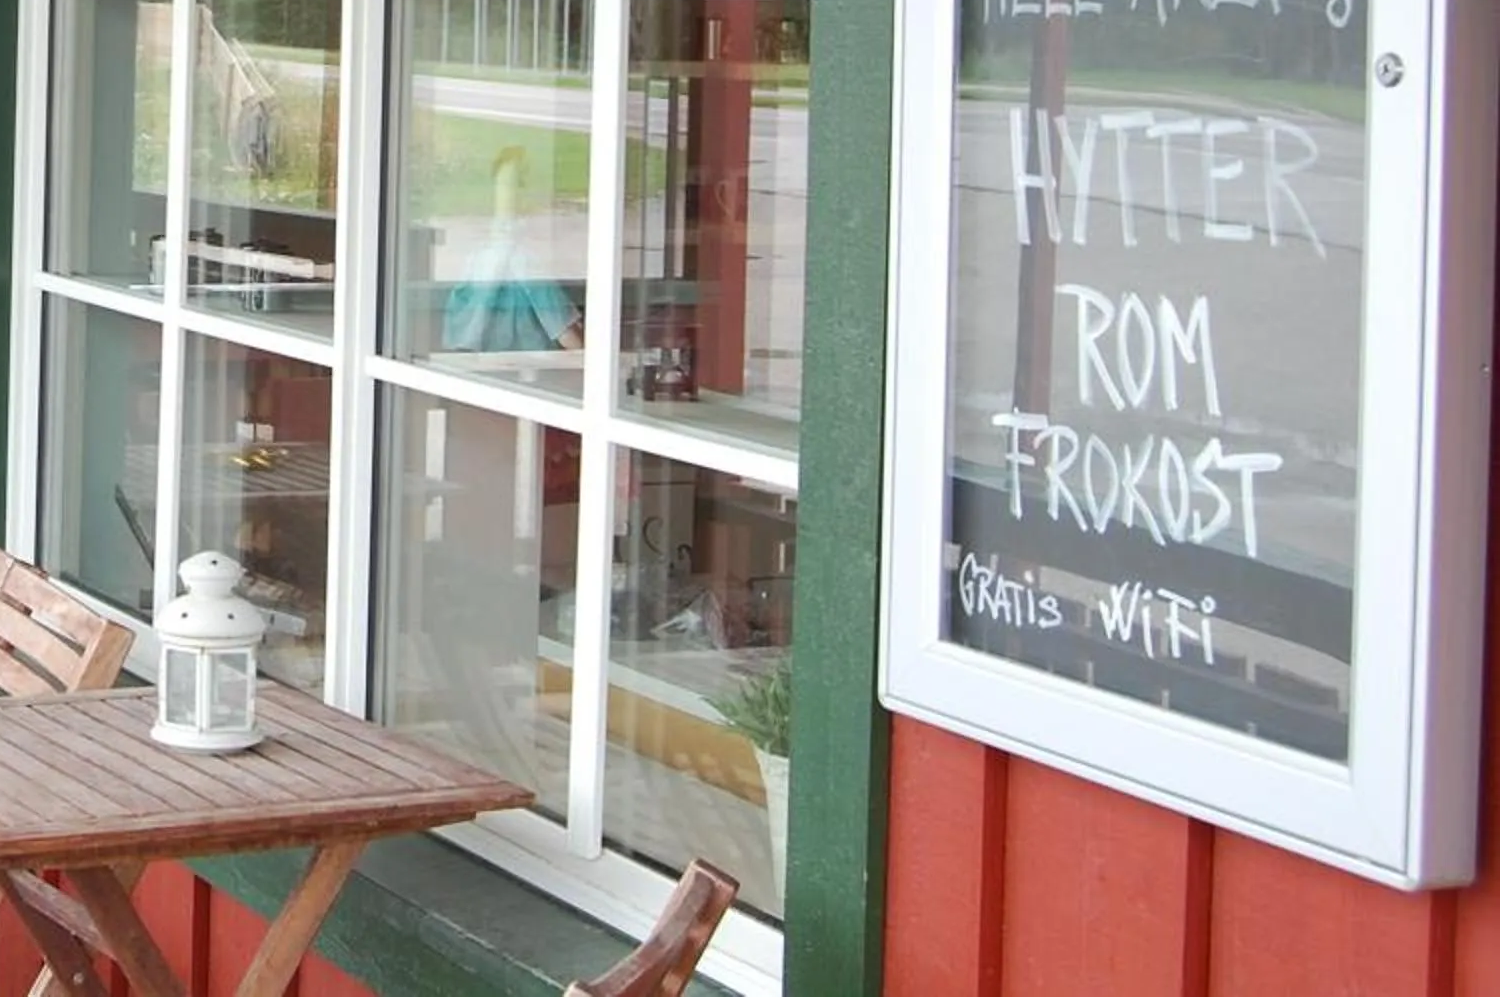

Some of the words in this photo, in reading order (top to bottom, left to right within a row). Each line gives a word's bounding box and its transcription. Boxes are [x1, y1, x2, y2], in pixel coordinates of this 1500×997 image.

[1009, 107, 1327, 261] HYTTER
[1056, 284, 1222, 417] ROM
[992, 407, 1284, 557] FROKOST
